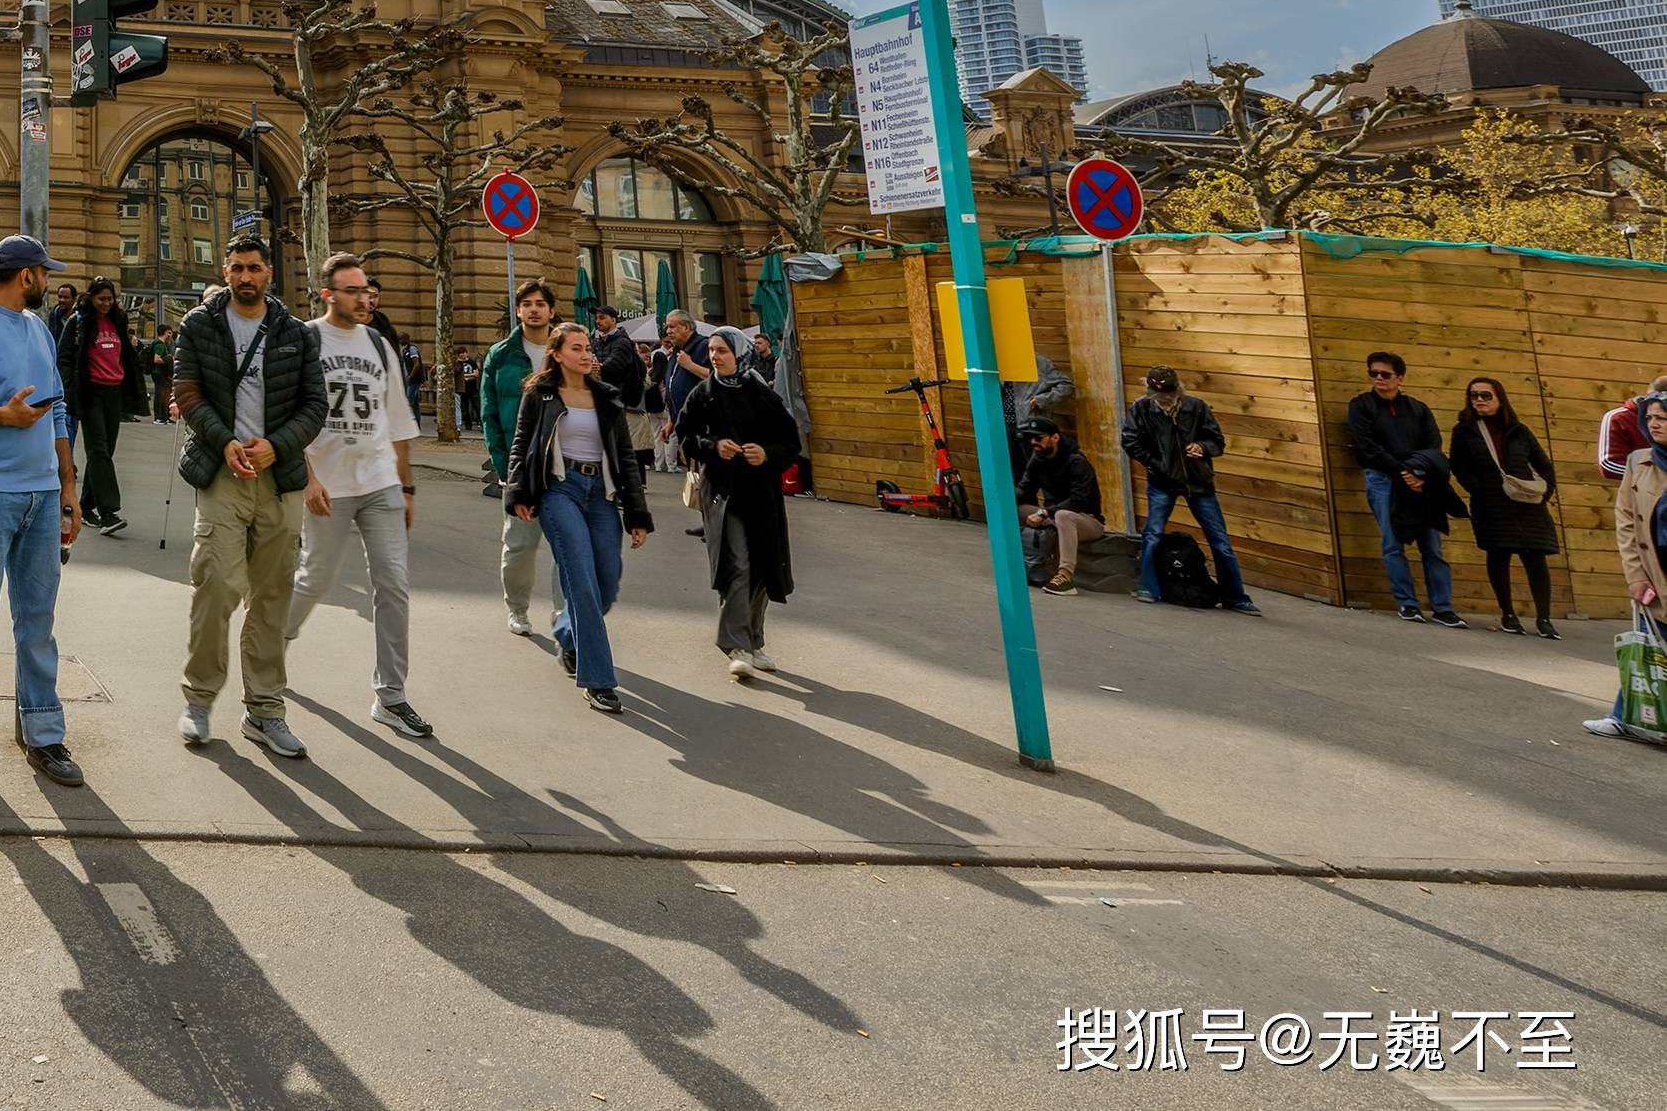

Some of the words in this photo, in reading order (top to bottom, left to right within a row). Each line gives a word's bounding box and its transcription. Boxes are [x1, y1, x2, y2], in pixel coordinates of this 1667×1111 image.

[854, 32, 913, 59] Hauptbahnhof
[868, 61, 879, 74] 64
[882, 73, 907, 84] Bornheim
[870, 80, 882, 93] N4
[883, 79, 914, 93] Seckbacher
[872, 100, 884, 112] N5
[885, 95, 928, 111] Fernbusterminal
[886, 110, 918, 121] Fechenheim
[871, 119, 887, 131] N11
[889, 129, 923, 141] Schwanheim
[872, 137, 889, 151] N12
[890, 136, 934, 150] Rheinlandstraße
[891, 149, 918, 159] Offenbach
[874, 156, 891, 170] N16
[892, 158, 925, 170] Stadtgrenze
[894, 170, 923, 181] Aussteigen
[879, 187, 941, 203] Schienenersatzverkehr
[321, 355, 383, 381] ALIFORNIA
[328, 382, 370, 419] 75
